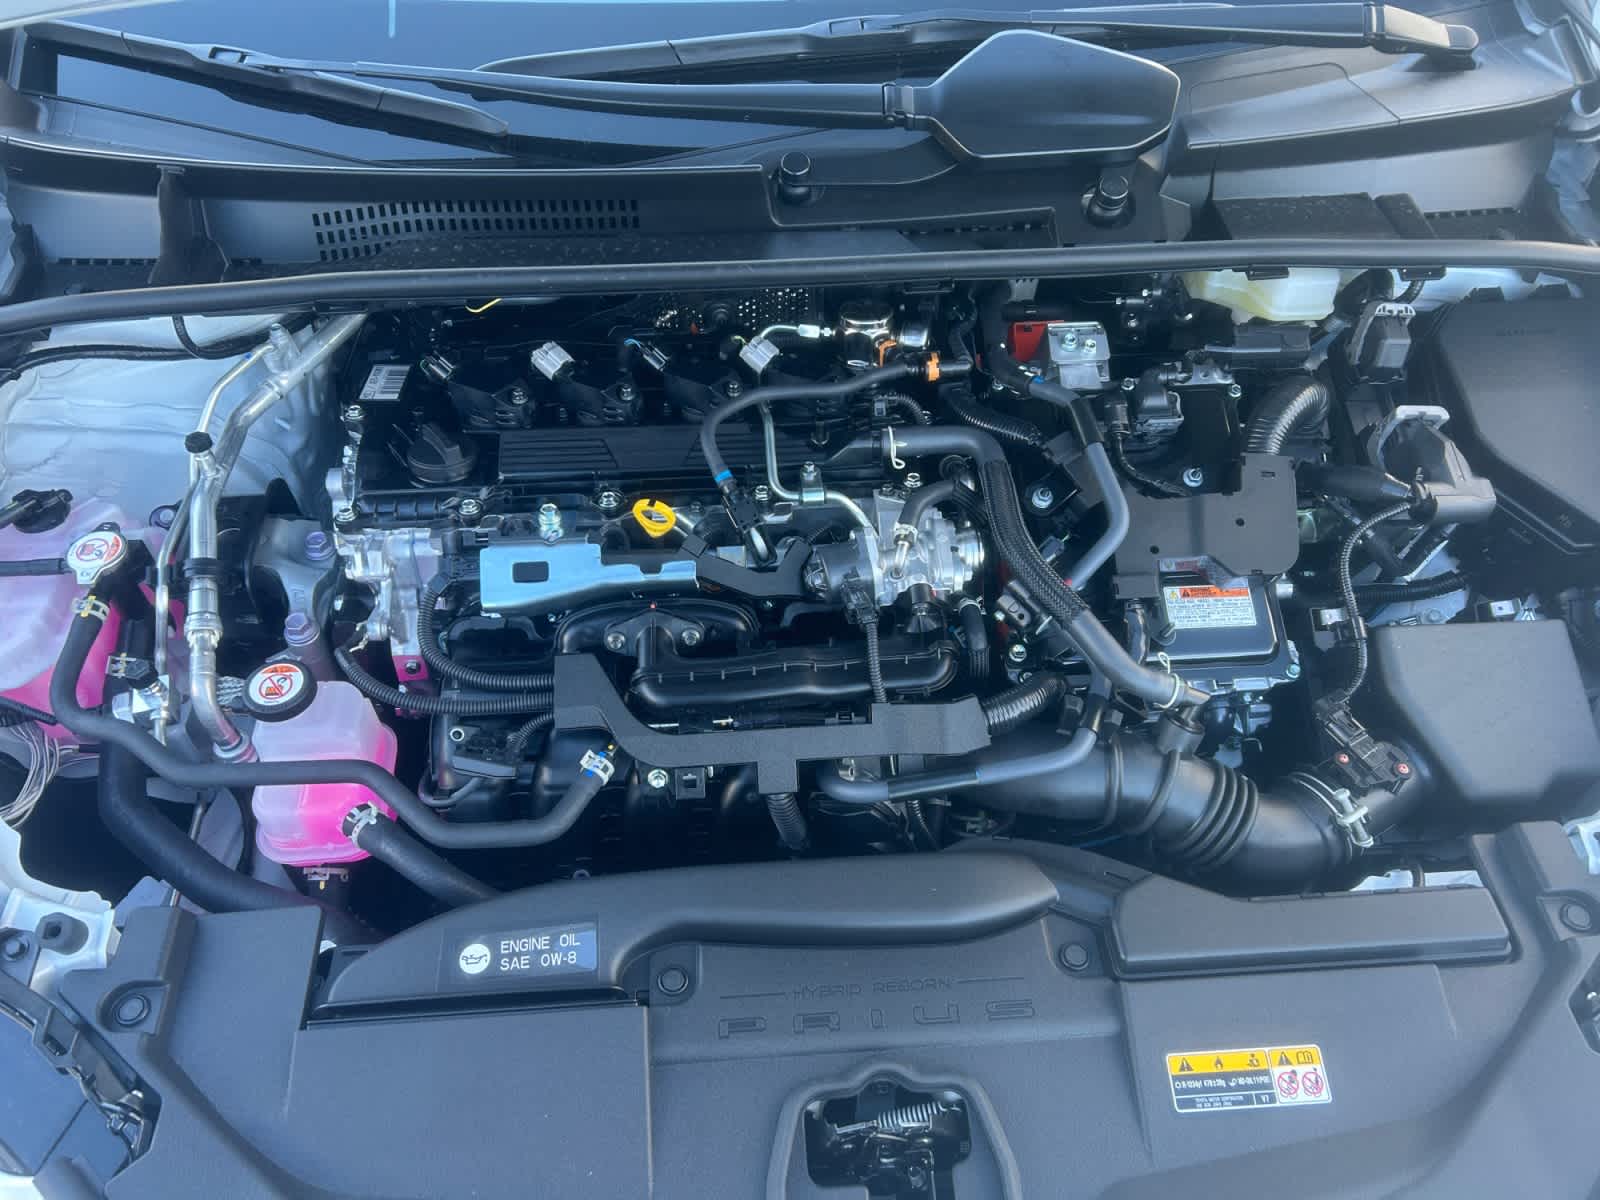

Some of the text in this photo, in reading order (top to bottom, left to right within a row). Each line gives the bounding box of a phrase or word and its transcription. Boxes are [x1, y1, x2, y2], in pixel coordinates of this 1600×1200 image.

[500, 933, 581, 954] ENGINE OIL
[500, 951, 577, 971] SAE 0W-8
[793, 977, 950, 1000] HYBRID REBORN
[718, 998, 1036, 1039] PRIUS
